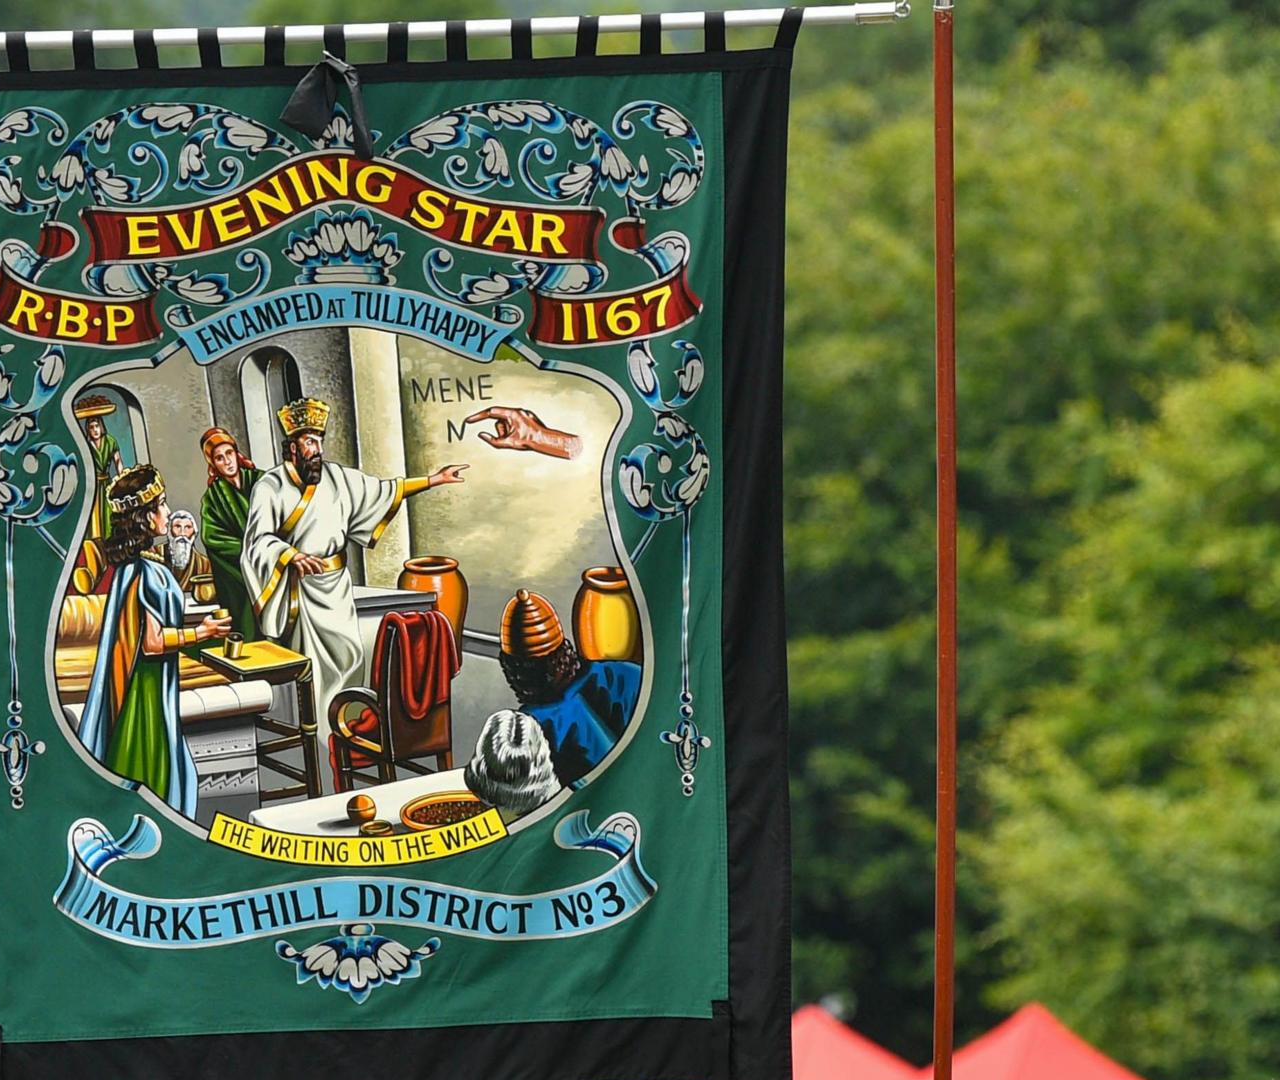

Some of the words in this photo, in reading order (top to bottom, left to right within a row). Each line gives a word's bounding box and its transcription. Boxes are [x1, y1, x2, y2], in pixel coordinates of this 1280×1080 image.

[125, 158, 397, 256] EVENING
[410, 189, 569, 255] STAR
[195, 292, 322, 355] ENCAMPED
[326, 298, 346, 319] AT
[351, 290, 499, 354] TULLYHAPPY
[561, 284, 673, 341] 1167
[410, 374, 493, 403] MENE
[219, 819, 255, 850] THE
[260, 833, 349, 863] WRITING
[359, 841, 385, 863] ON
[391, 834, 436, 861] THE
[438, 816, 501, 851] WALL
[83, 886, 338, 942] MARKETHILL
[358, 884, 533, 935] DISTRICT
